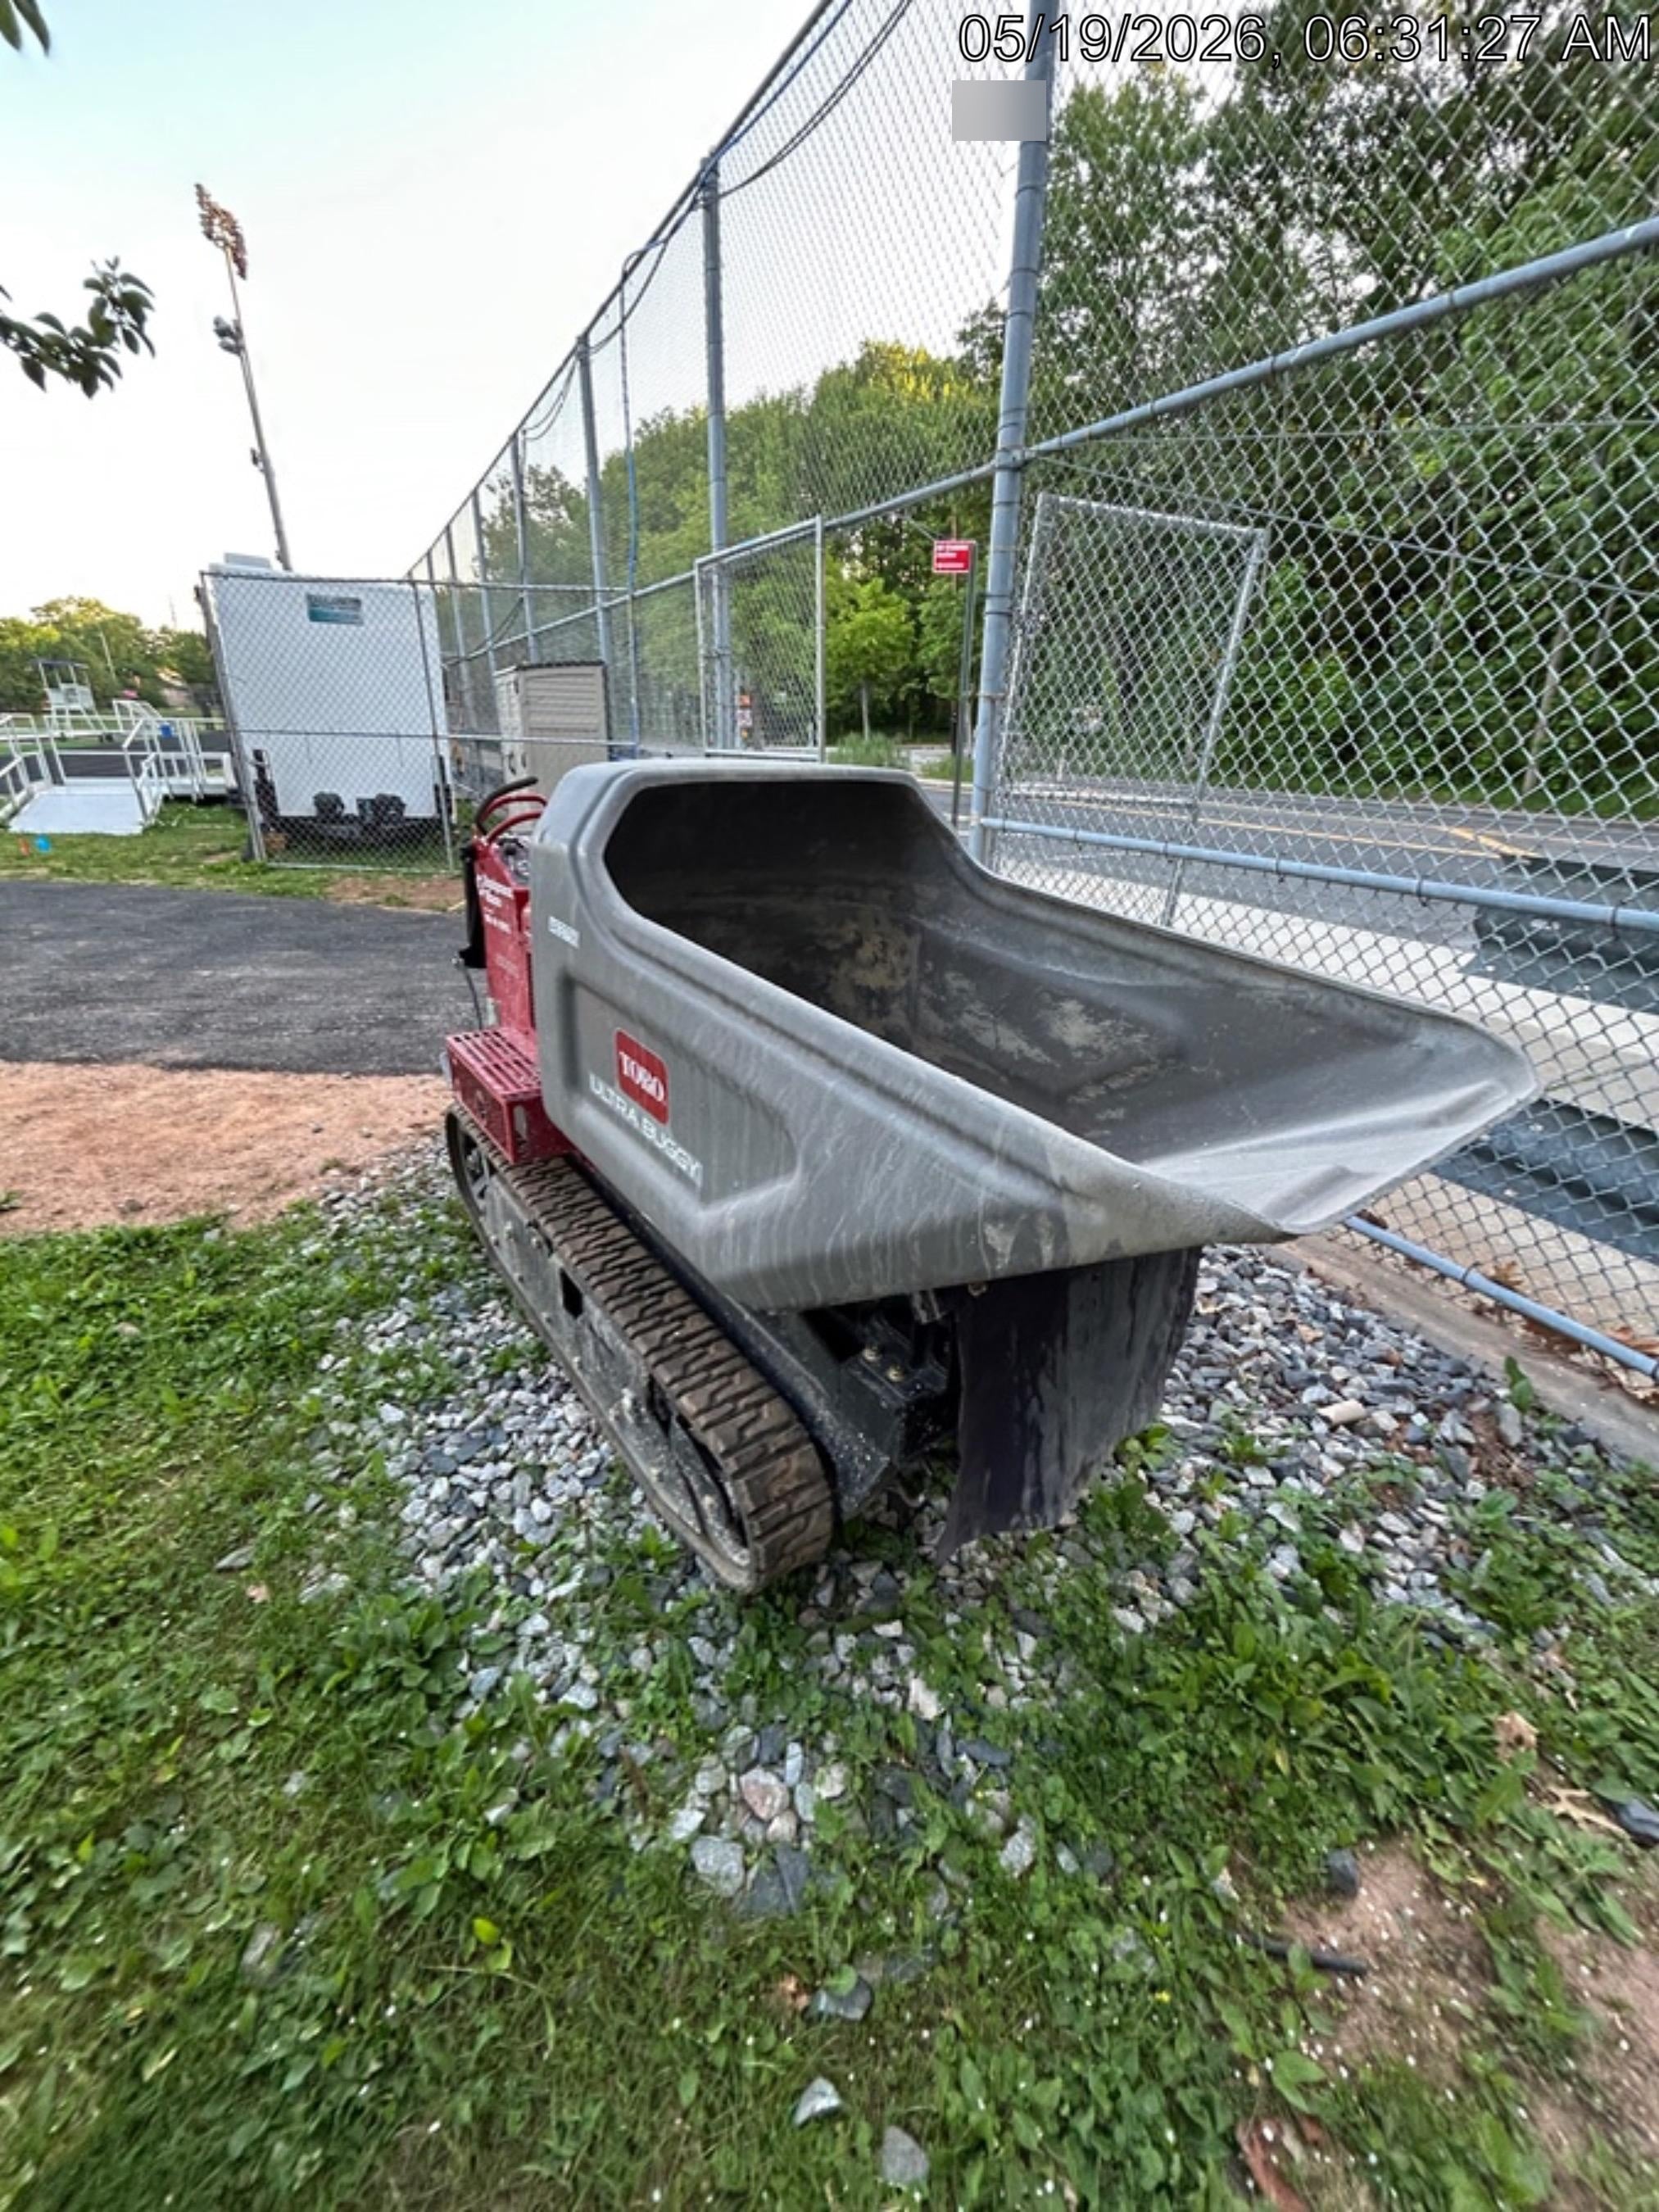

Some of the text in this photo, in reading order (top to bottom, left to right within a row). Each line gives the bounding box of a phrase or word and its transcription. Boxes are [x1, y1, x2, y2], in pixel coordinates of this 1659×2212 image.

[619, 1051, 664, 1102] TORO
[588, 1073, 703, 1188] ULTRA BUGGY
